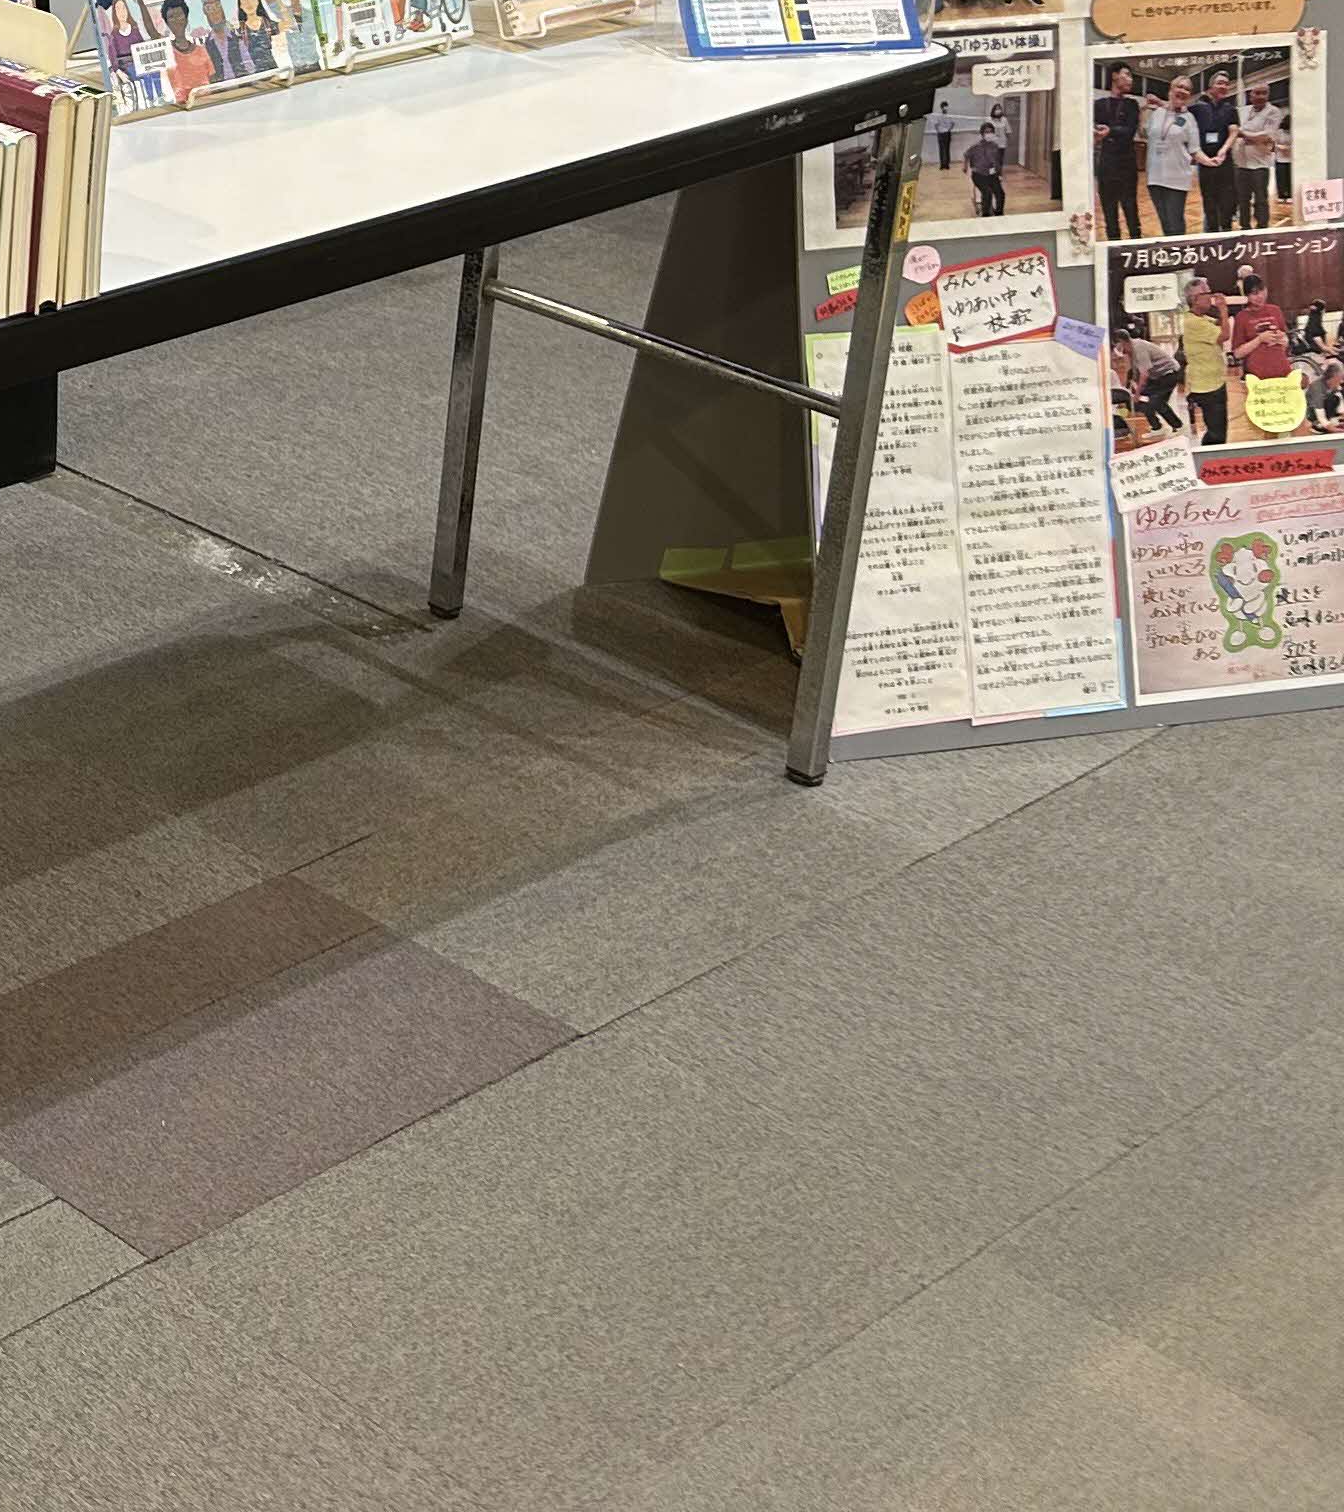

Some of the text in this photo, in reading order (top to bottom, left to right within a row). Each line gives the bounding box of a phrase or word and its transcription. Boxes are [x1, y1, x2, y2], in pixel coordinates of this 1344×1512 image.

[1119, 235, 1339, 269] 7月ゆうあいレクリエーション
[1135, 496, 1243, 530] ゆあちゃん
